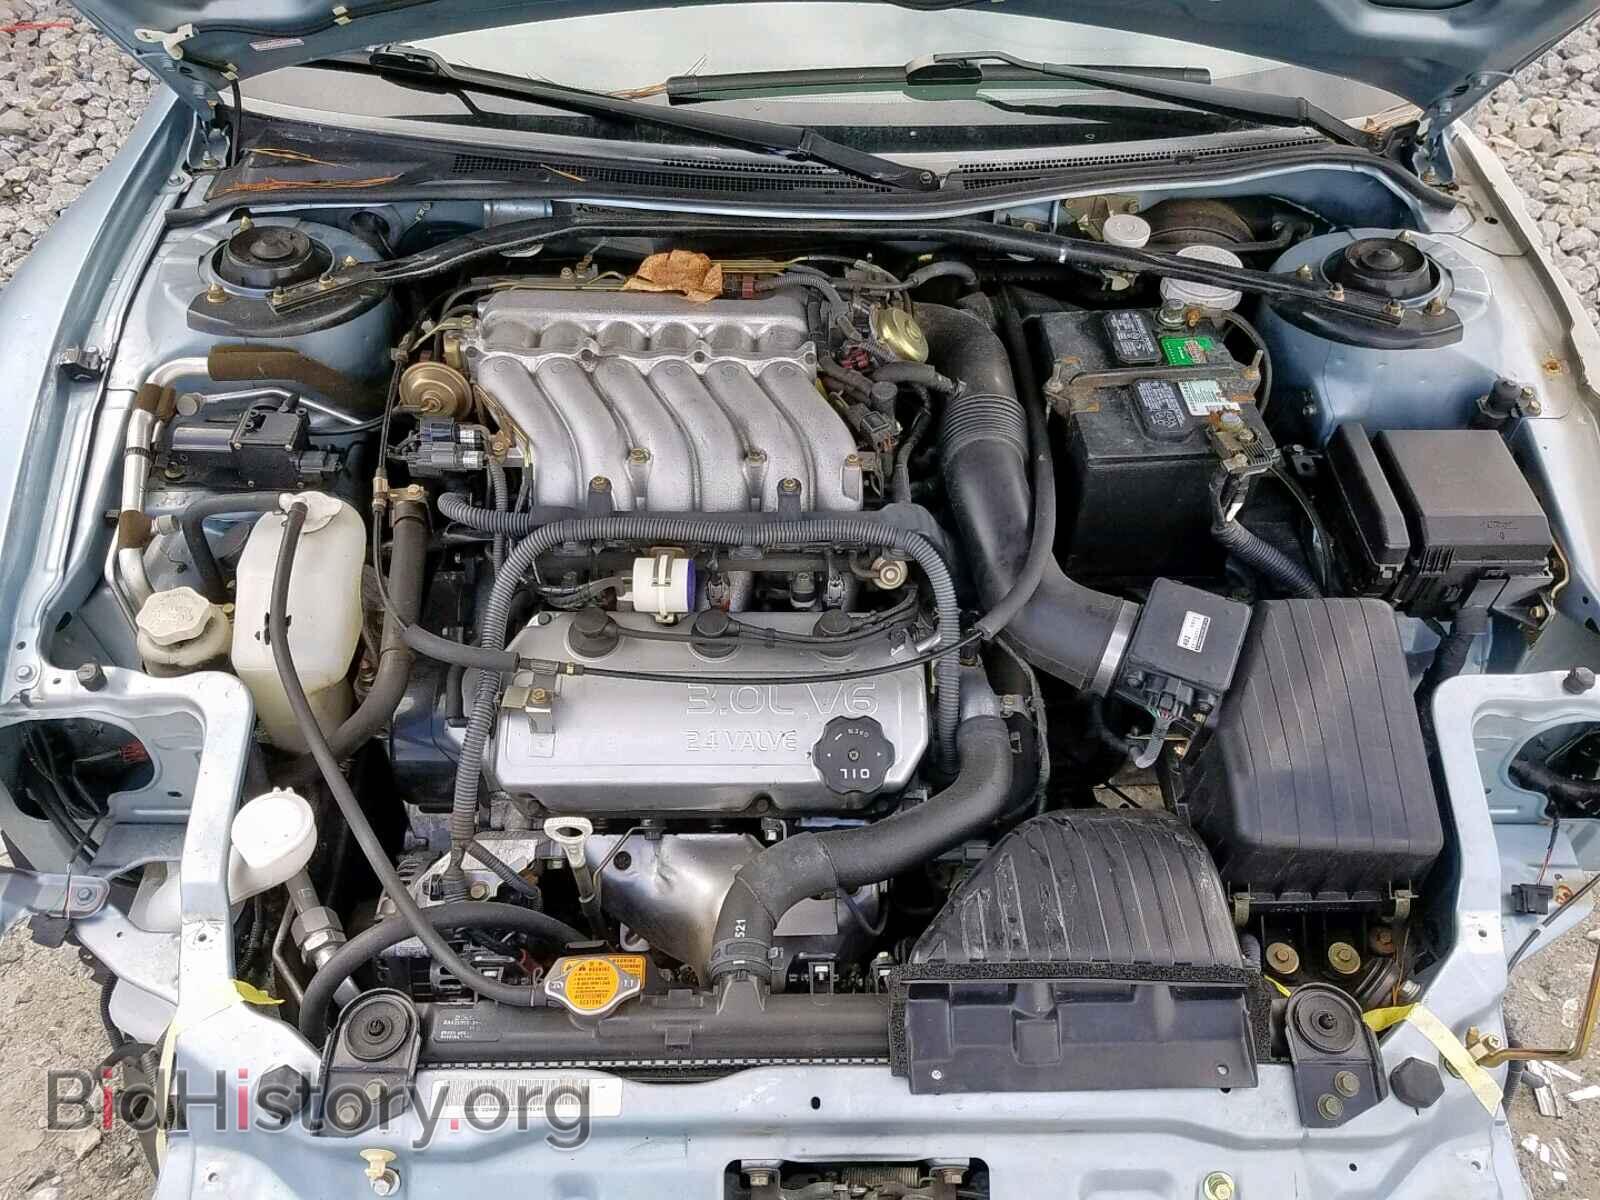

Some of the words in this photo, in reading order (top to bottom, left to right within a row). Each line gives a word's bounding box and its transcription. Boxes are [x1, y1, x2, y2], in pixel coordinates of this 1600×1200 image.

[686, 683, 794, 715] 3.0L
[805, 682, 880, 716] V6
[839, 768, 870, 780] OIL
[734, 919, 747, 938] 521
